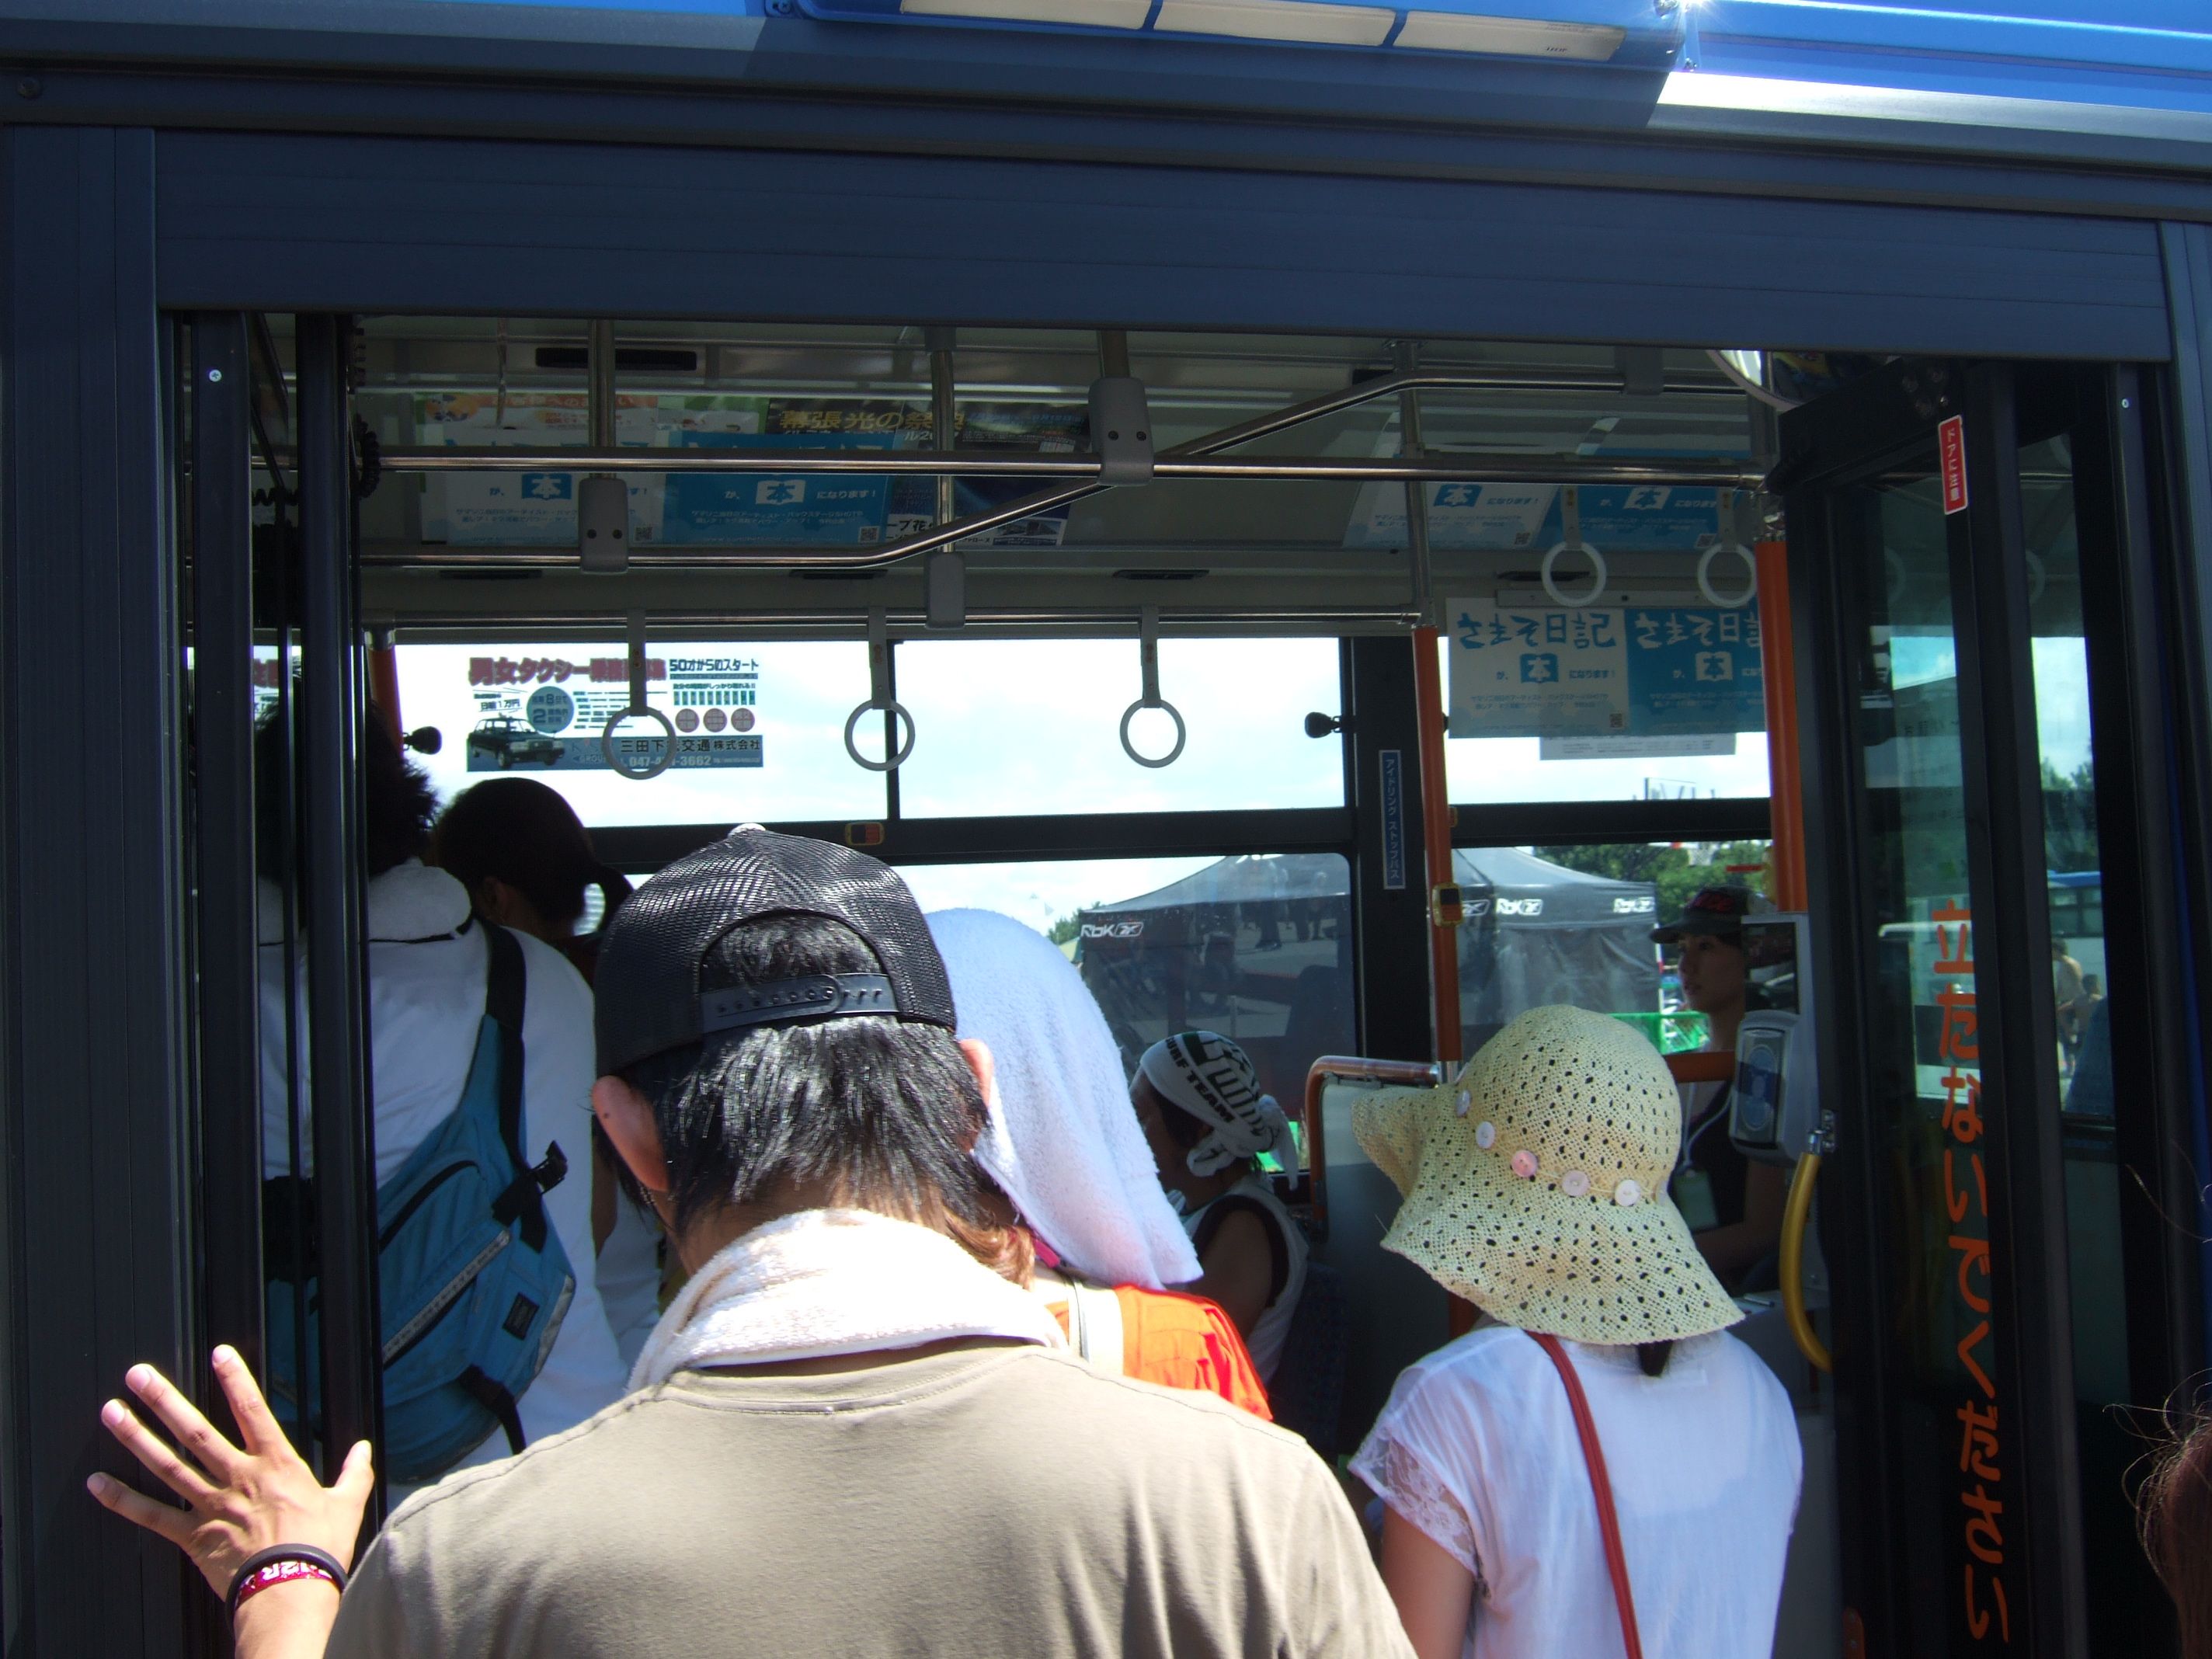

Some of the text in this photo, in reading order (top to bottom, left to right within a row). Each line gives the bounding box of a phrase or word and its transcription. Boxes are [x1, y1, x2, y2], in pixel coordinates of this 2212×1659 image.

[669, 659, 759, 672] 50才からのスタート
[621, 739, 760, 753] 三田下交通株式会社
[628, 755, 711, 767] 047-4-3662
